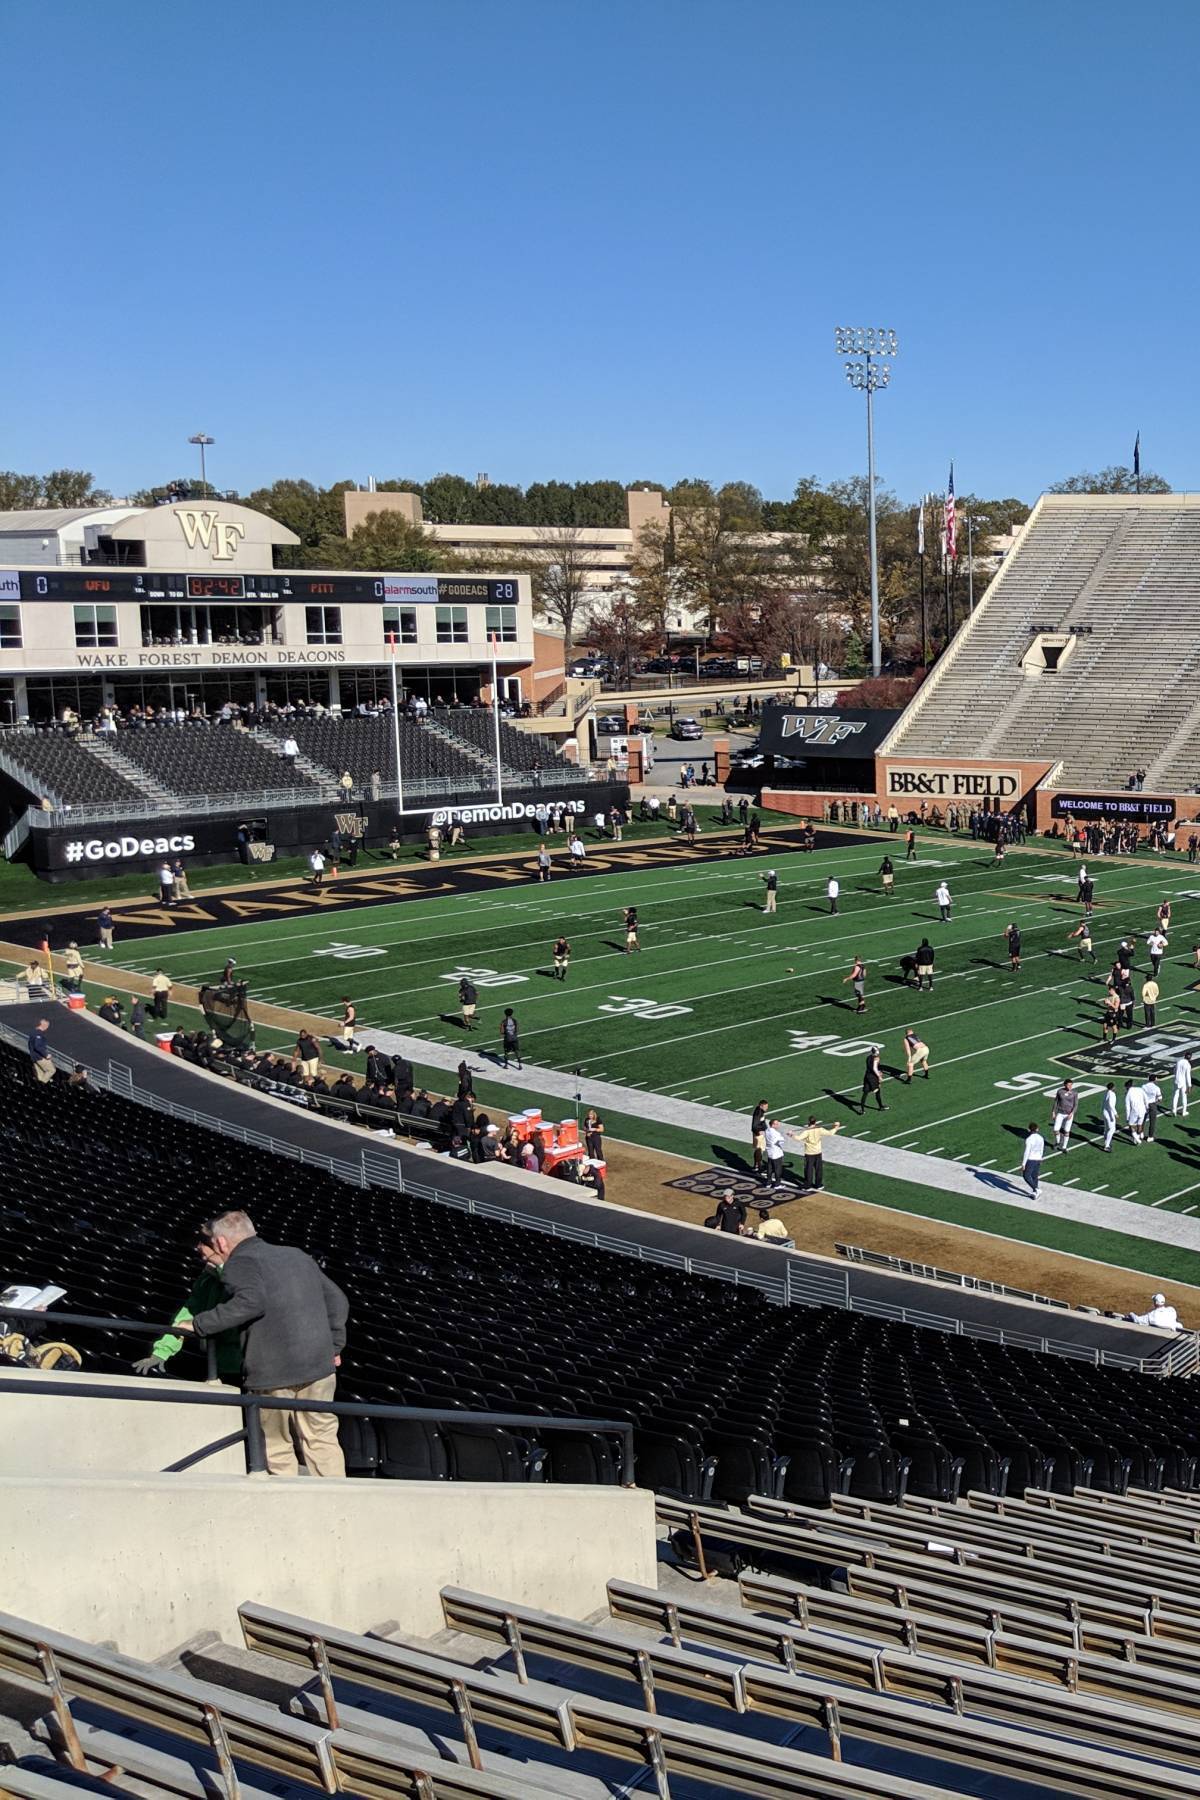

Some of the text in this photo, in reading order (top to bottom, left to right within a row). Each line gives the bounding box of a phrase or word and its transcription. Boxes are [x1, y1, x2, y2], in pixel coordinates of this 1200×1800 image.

[172, 509, 245, 560] WF
[36, 576, 48, 594] 0
[310, 583, 334, 593] PITT
[374, 581, 383, 597] 0
[384, 585, 437, 595] alarmsouth
[438, 583, 488, 596] #GODEACS
[495, 583, 513, 598] 28
[78, 651, 345, 667] WAKE FOREST DEMON DEACONS
[781, 714, 867, 744] WF
[889, 772, 1017, 797] BB&T FIELD
[1059, 800, 1173, 814] WELCOME TO BB&T FIELD
[334, 812, 369, 838] WF
[66, 834, 195, 863] #GoDeacs
[248, 842, 275, 862] WF
[85, 878, 457, 926] WAKE
[598, 998, 693, 1020] 30
[788, 1033, 886, 1057] 40
